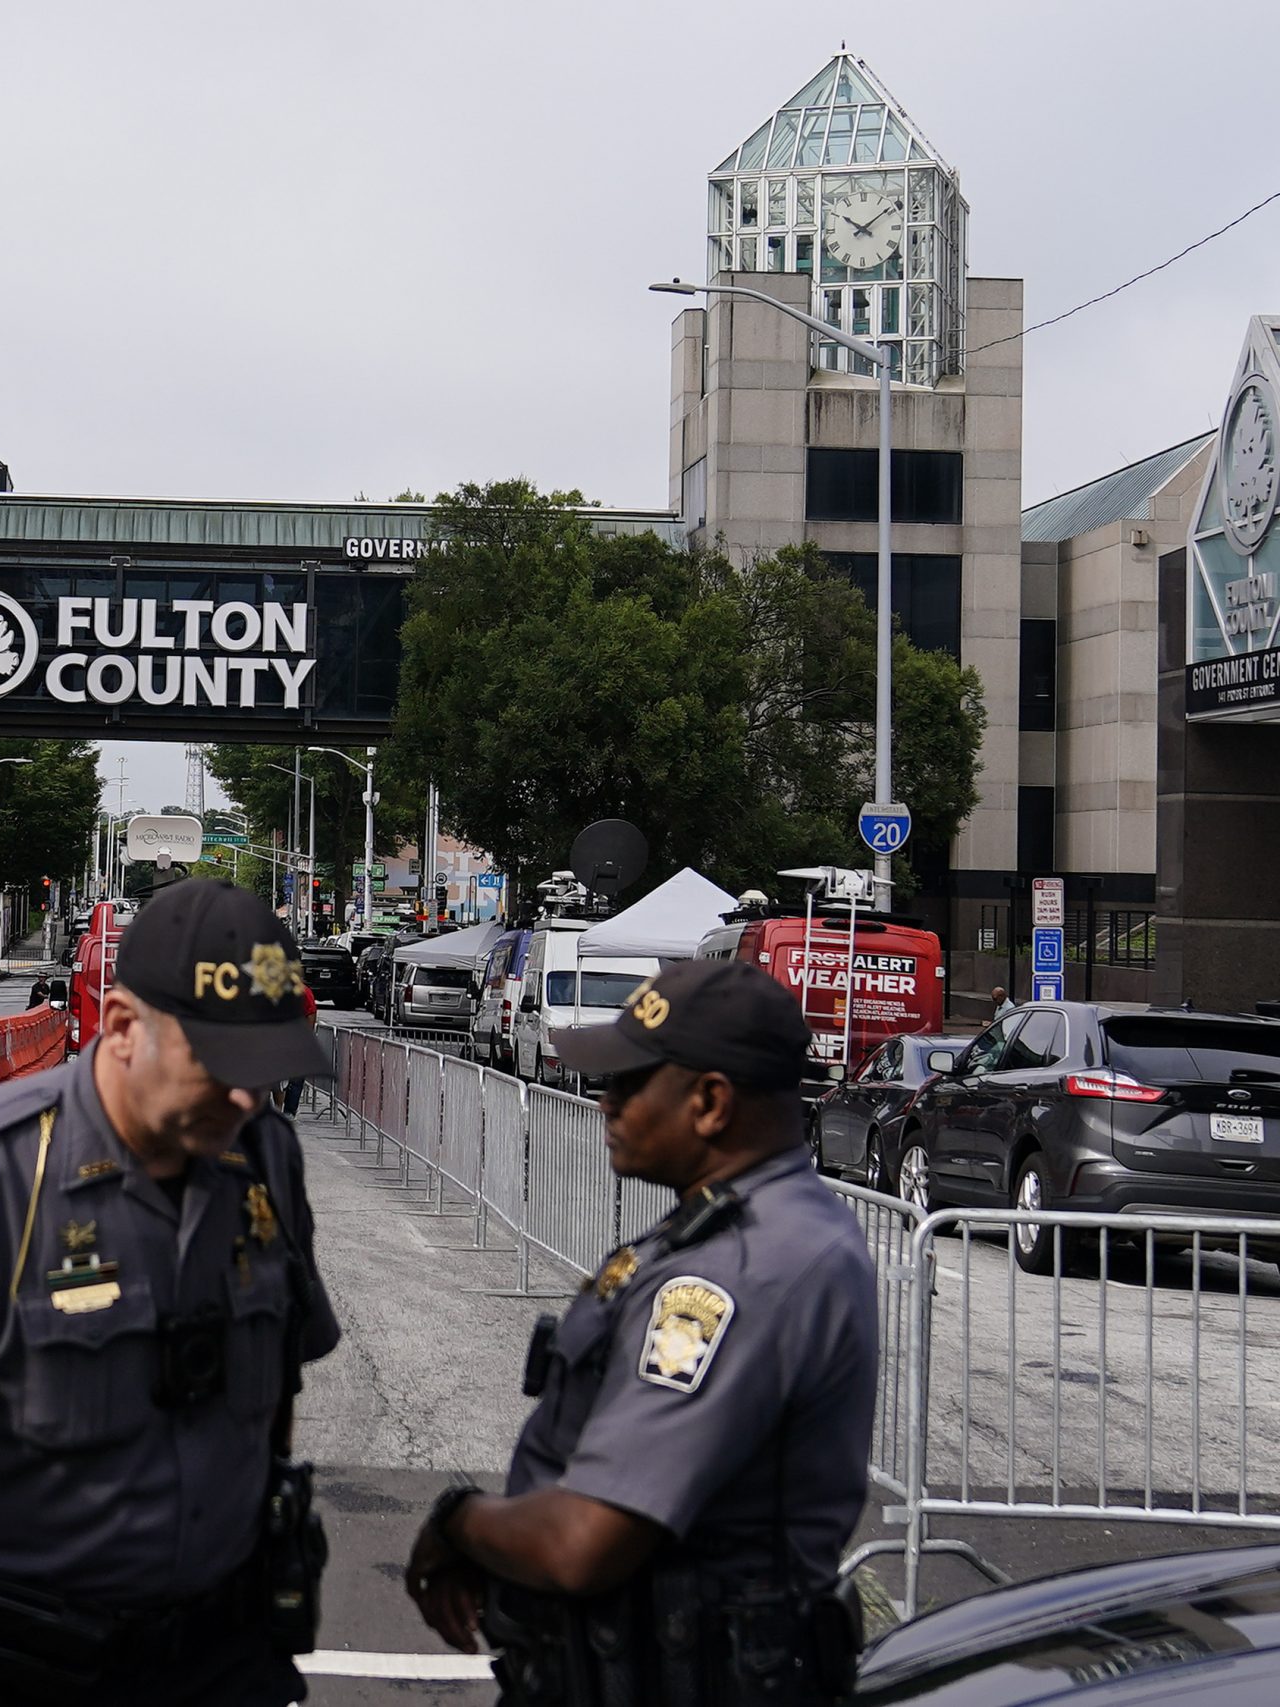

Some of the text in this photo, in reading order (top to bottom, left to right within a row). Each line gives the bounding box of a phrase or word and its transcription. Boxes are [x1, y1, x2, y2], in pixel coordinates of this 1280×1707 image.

[57, 596, 308, 653] FULTON
[45, 652, 317, 710] COUNTY
[1192, 656, 1259, 691] GOVERNMENT
[873, 823, 900, 846] 20
[790, 950, 914, 972] FRST ALERT
[194, 961, 240, 1000] FC
[787, 967, 916, 995] WEATHER
